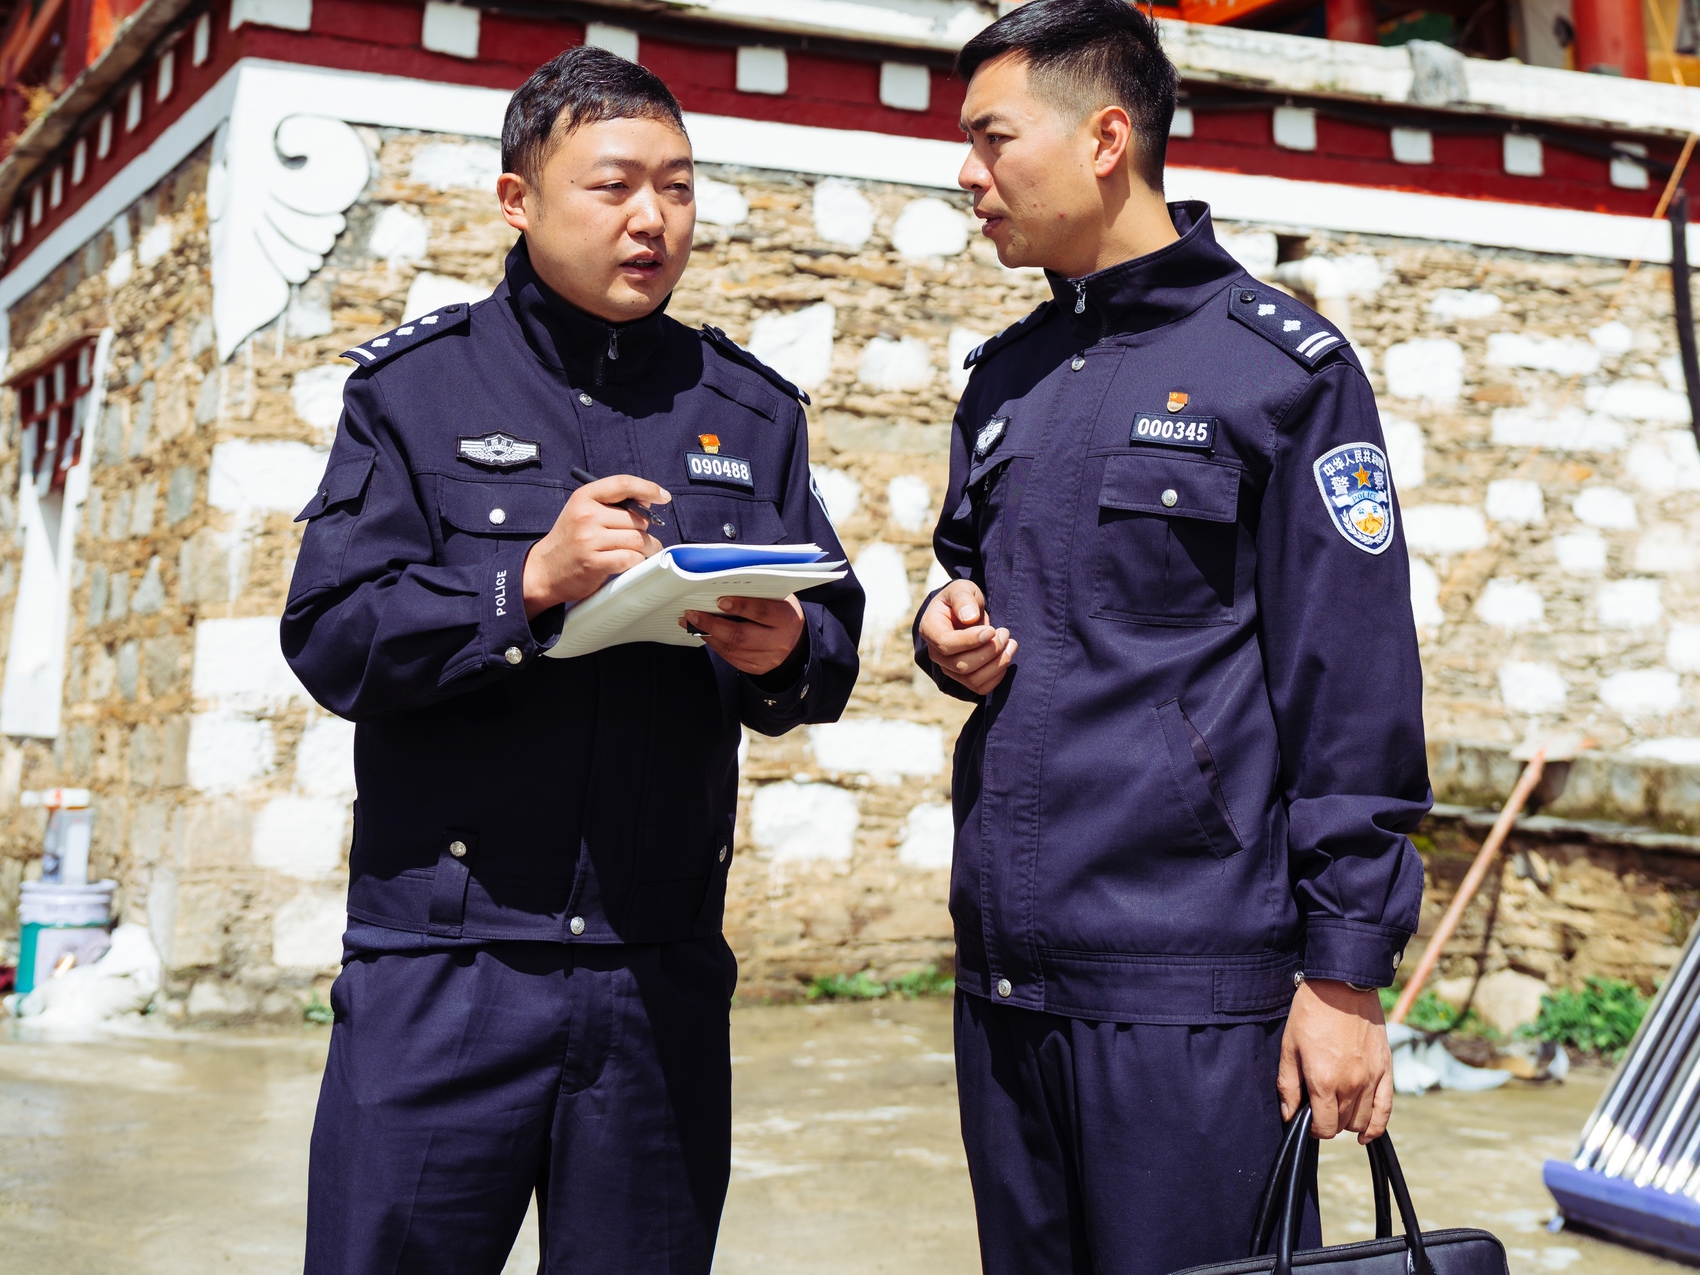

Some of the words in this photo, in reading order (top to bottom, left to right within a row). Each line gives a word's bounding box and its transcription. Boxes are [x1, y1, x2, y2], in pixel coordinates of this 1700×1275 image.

[1138, 418, 1208, 441] 000345
[691, 458, 749, 480] 090488
[1352, 491, 1378, 502] POLICE
[495, 570, 507, 617] POLICE
